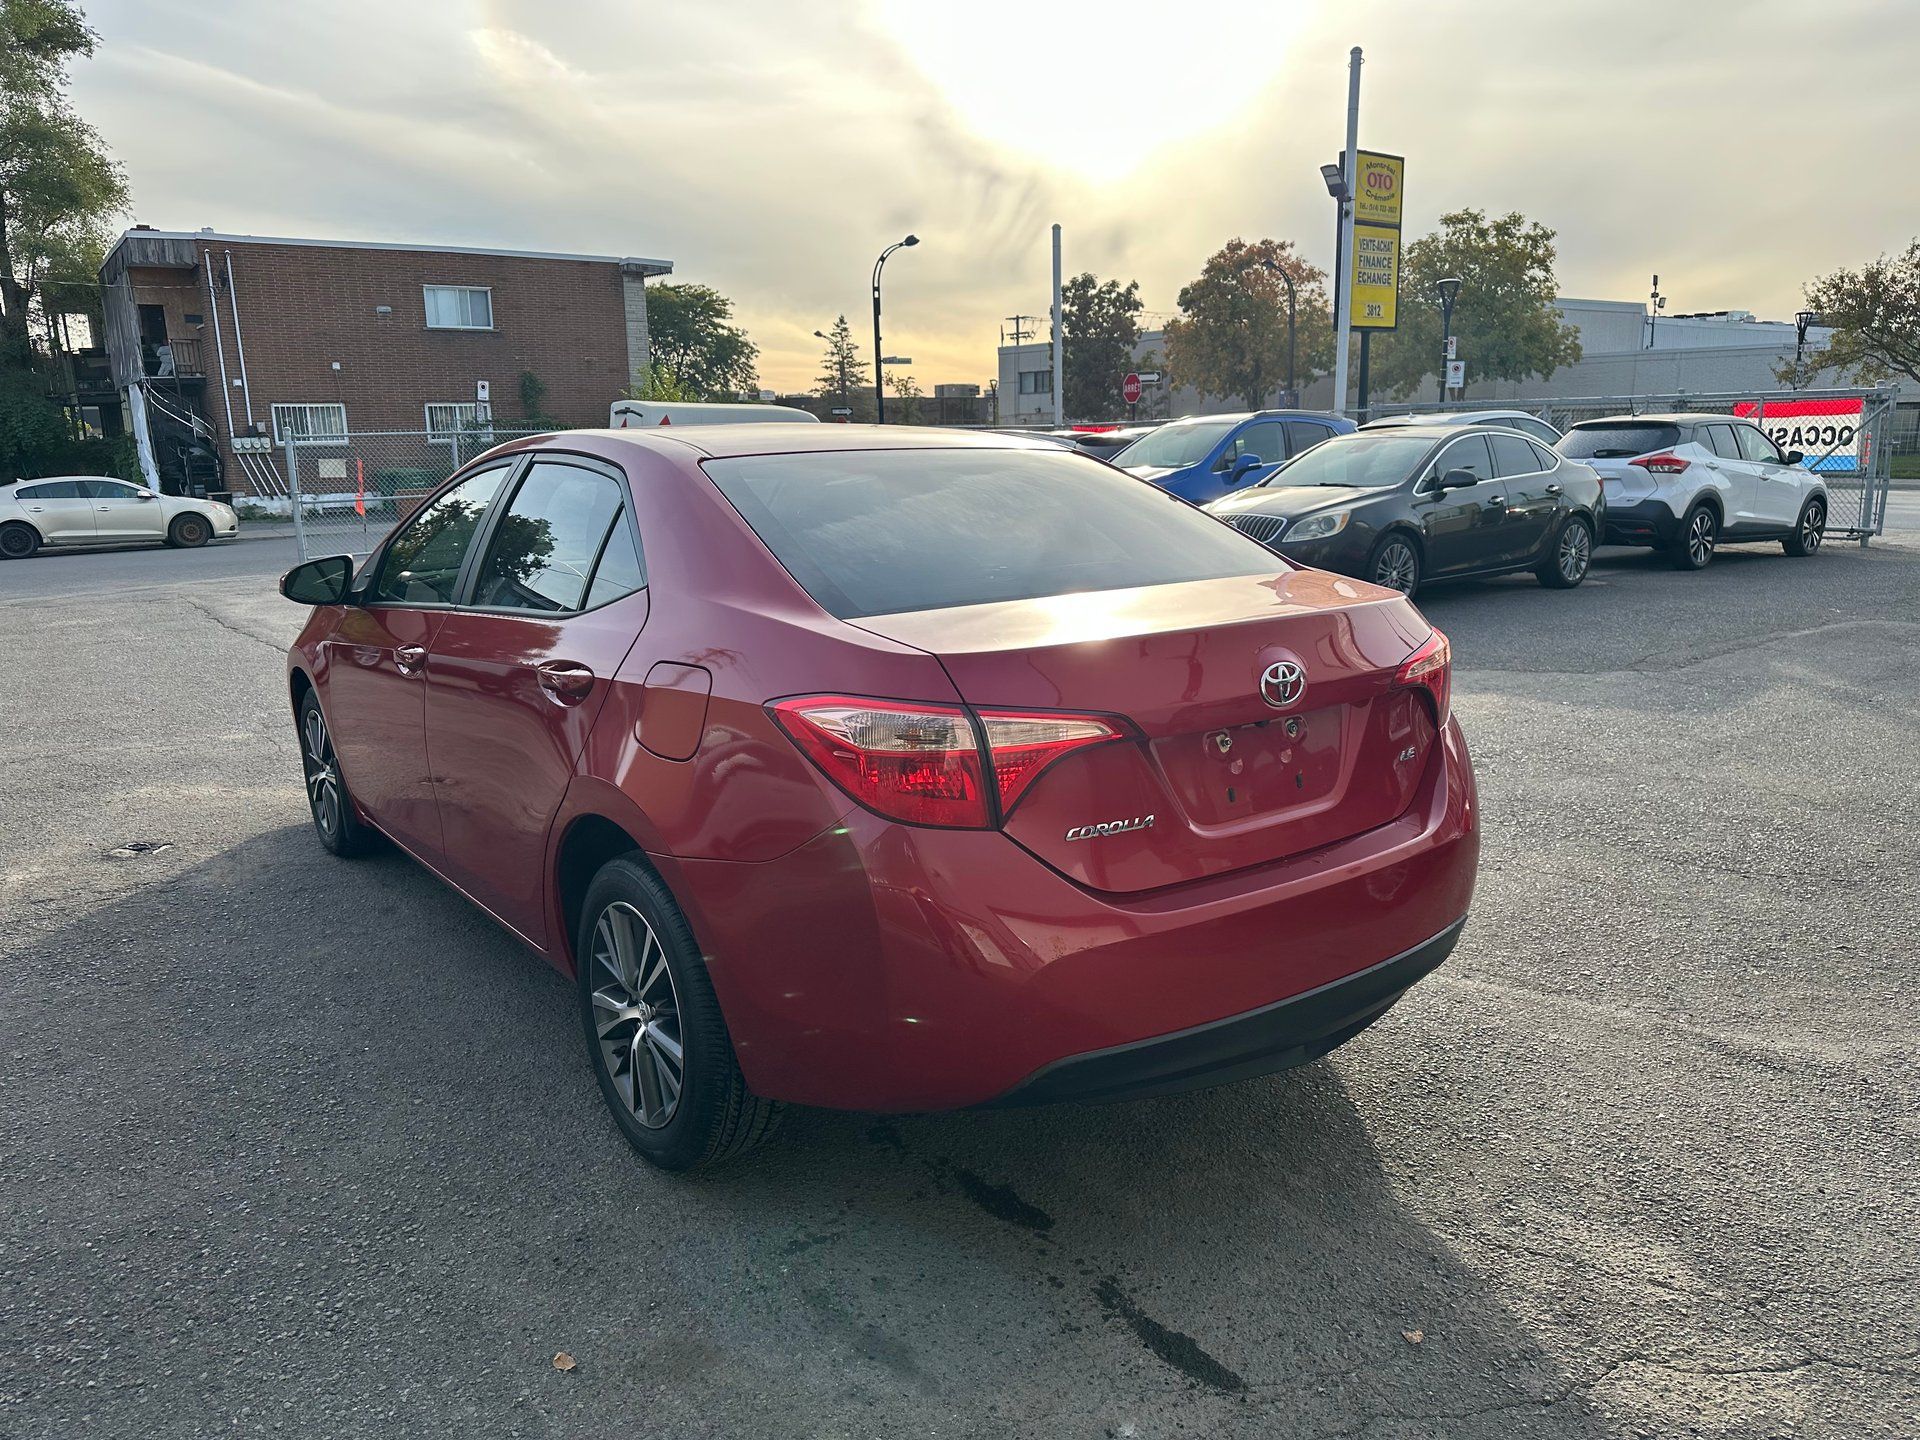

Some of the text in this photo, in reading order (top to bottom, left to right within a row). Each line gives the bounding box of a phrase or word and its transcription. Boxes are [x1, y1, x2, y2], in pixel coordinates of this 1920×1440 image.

[1367, 172, 1393, 190] OTO
[1359, 238, 1394, 252] VENTE-ACHAT
[1358, 254, 1393, 269] FINANCE
[1357, 271, 1392, 285] ECHANGE
[1366, 304, 1381, 316] 3812
[1124, 382, 1140, 392] ARRÊT
[1400, 746, 1416, 761] LE
[1065, 814, 1155, 841] COROLLA
